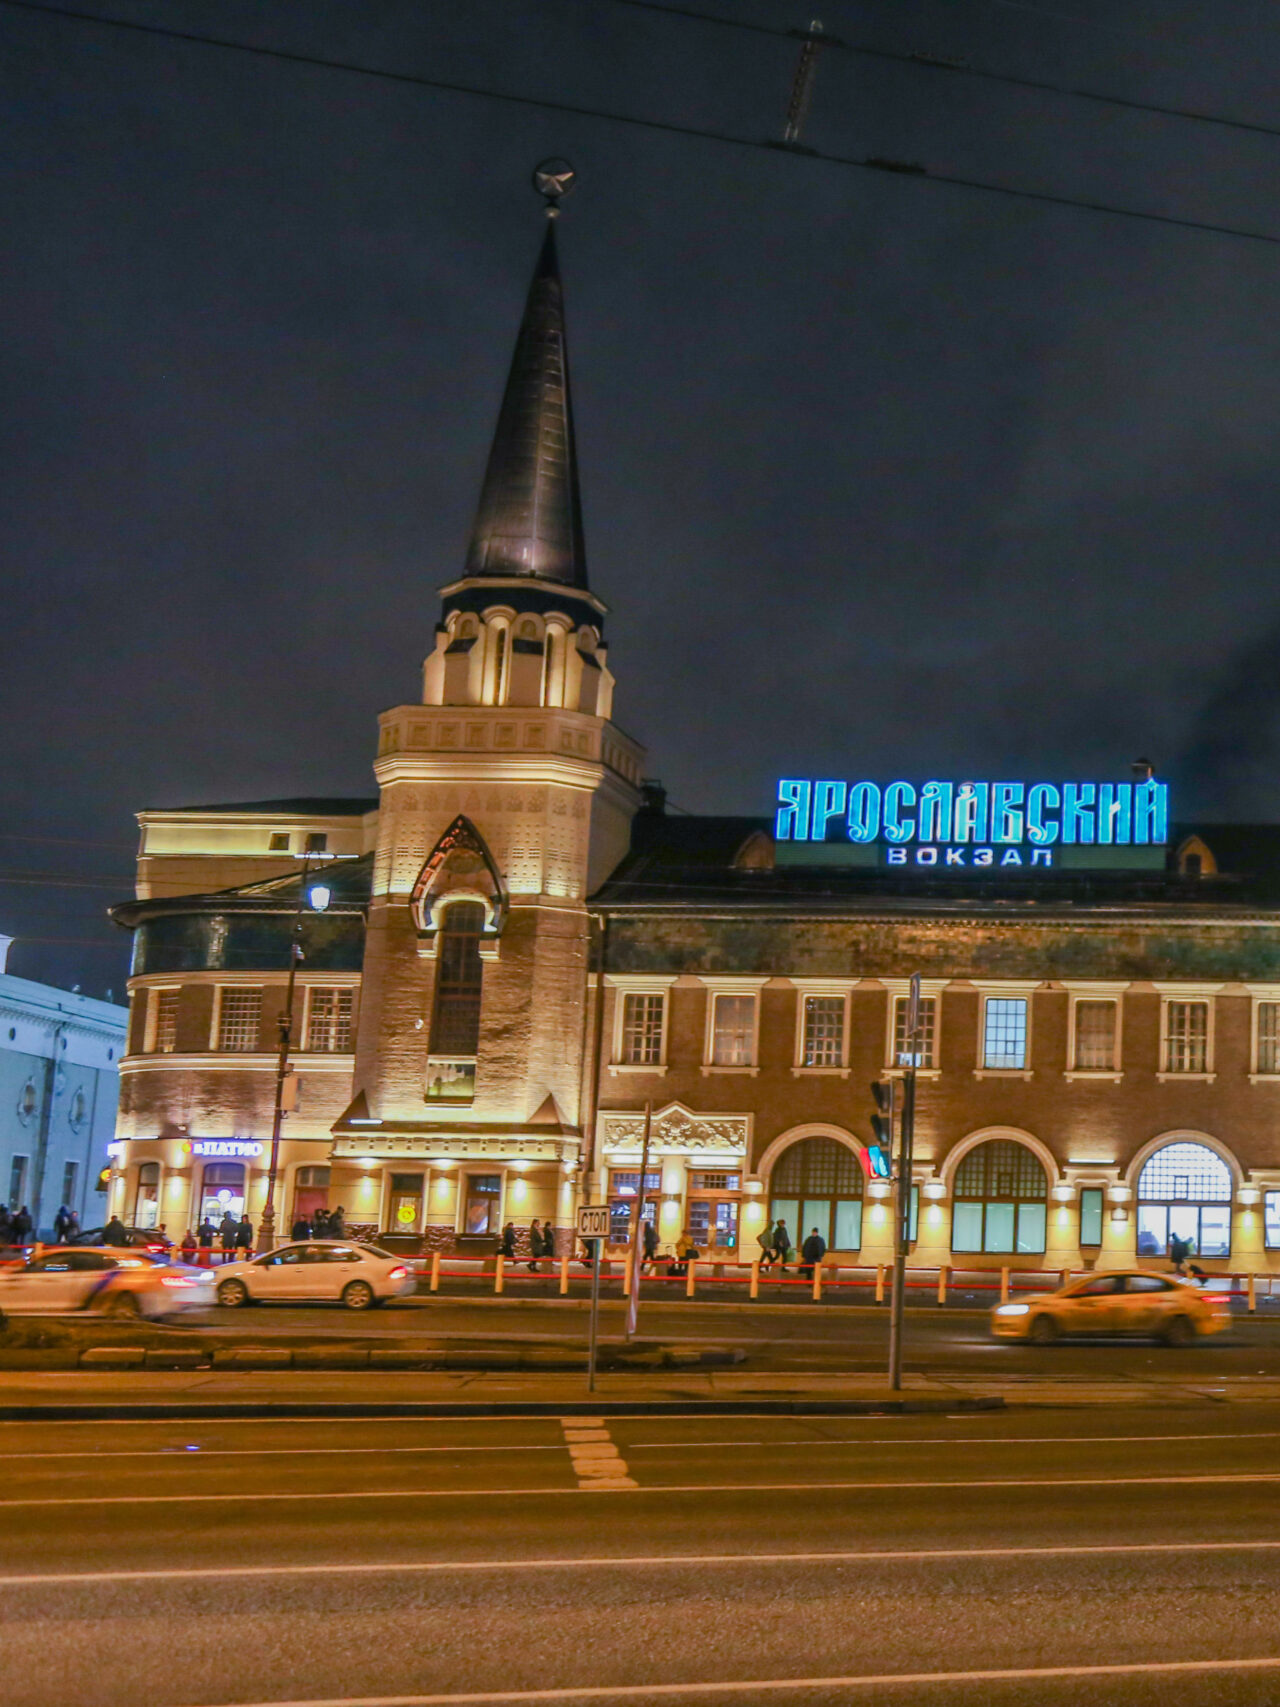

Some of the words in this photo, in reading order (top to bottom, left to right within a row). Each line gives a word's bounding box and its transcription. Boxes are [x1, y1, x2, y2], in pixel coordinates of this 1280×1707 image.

[776, 777, 1169, 845] ЯРОСЛАВСКИЙ
[887, 847, 1053, 866] ВОКЗАЛ
[581, 1211, 607, 1232] СТОП
